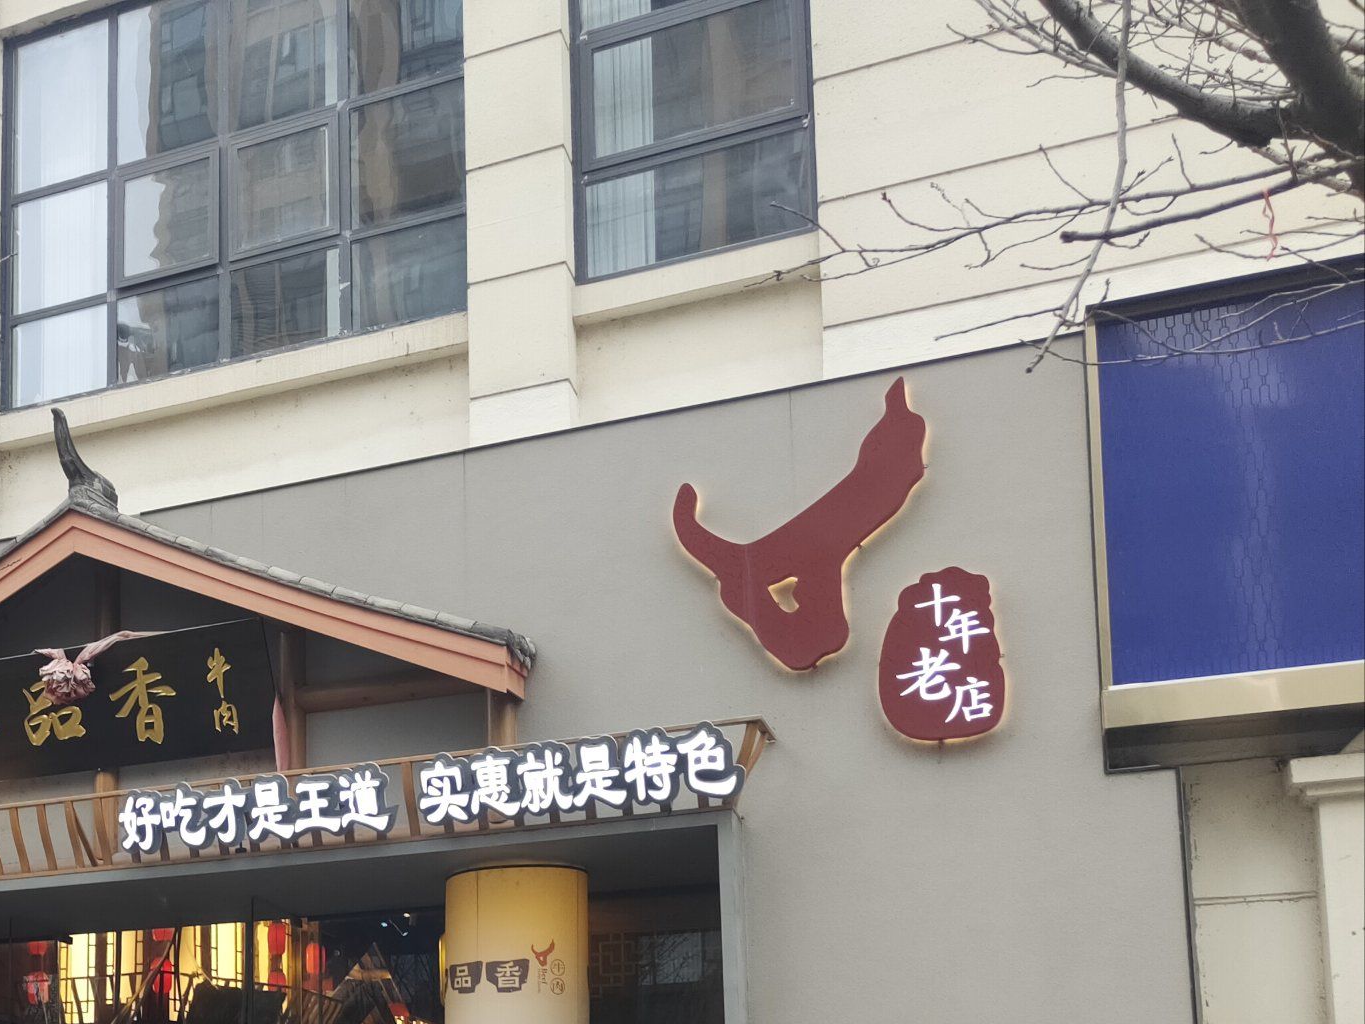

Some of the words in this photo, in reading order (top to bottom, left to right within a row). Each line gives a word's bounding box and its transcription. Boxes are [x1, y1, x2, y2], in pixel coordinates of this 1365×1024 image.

[206, 647, 239, 735] 牛肉
[118, 770, 389, 851] 好吃才是王道
[419, 729, 738, 823] 实惠就是特色
